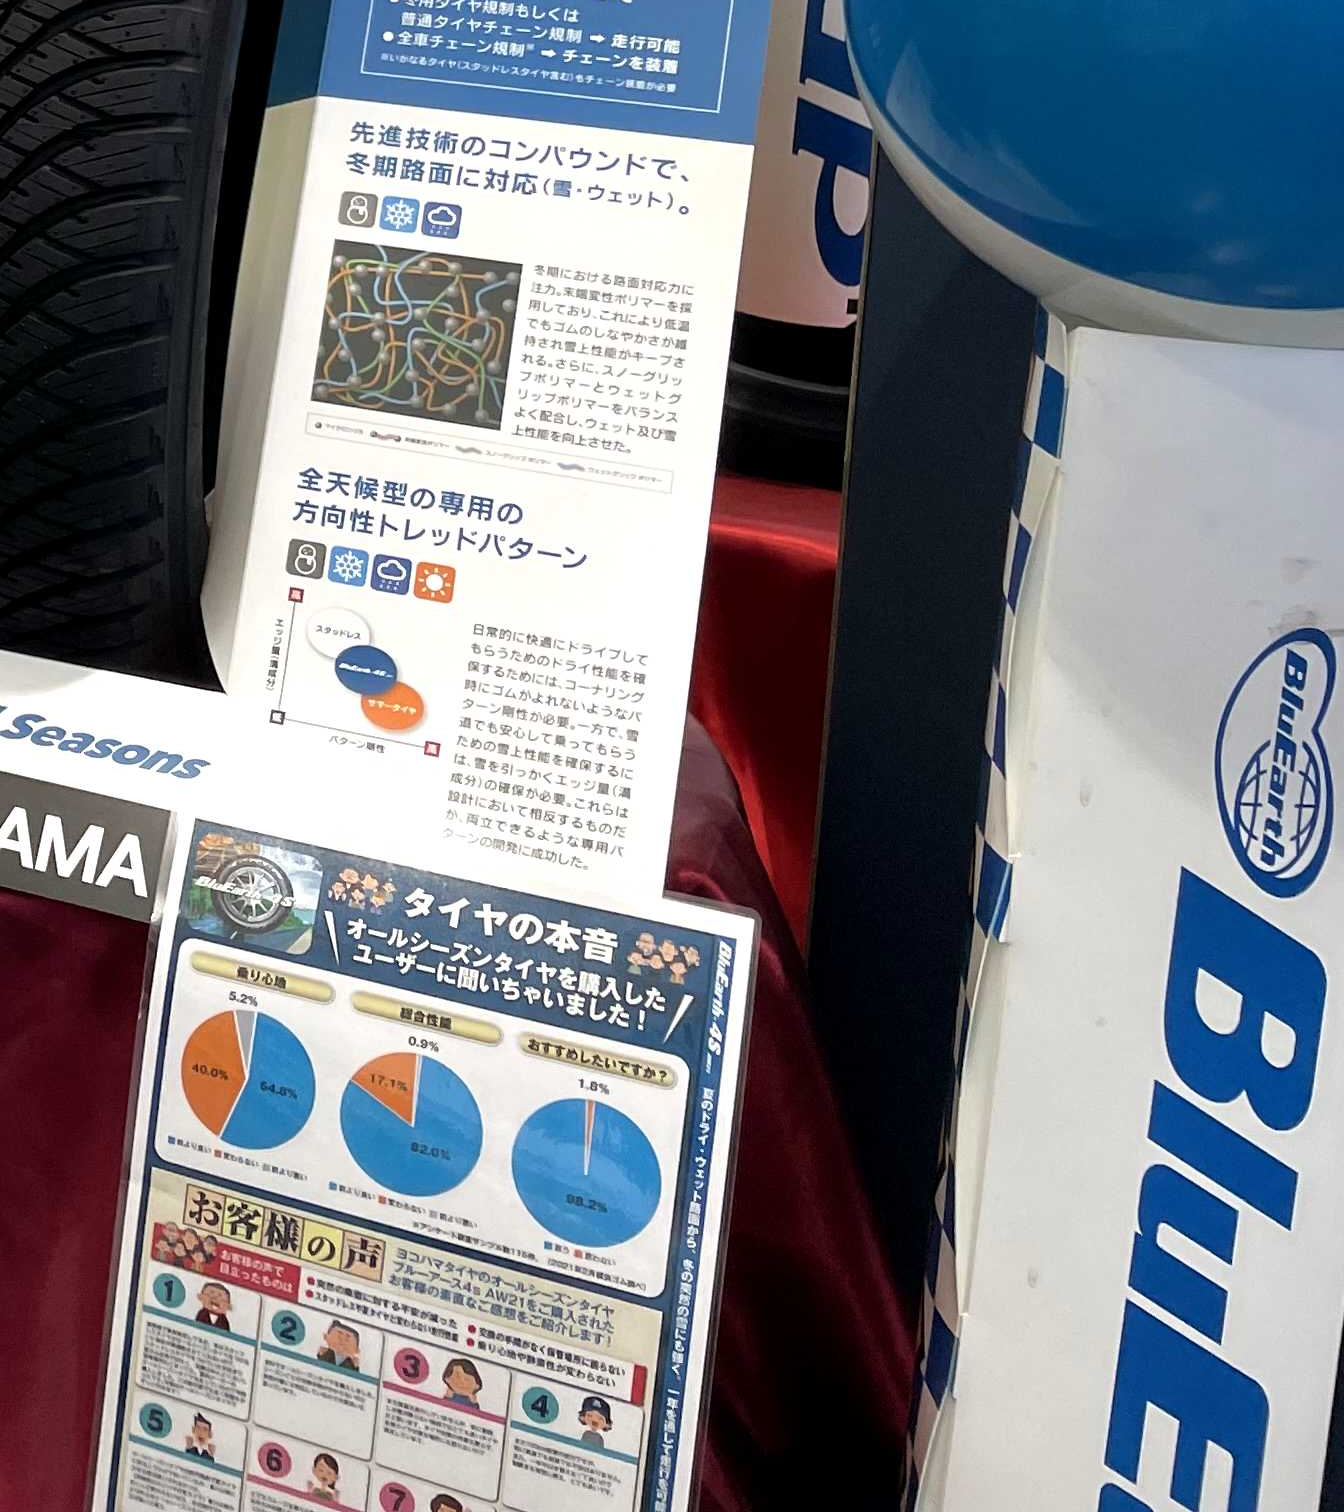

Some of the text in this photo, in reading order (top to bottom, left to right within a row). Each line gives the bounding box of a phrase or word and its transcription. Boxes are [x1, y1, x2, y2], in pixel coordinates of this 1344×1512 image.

[401, 12, 681, 54] 普通タイヤチェーン規制 走行可能
[562, 49, 678, 74] チェーンを装着
[534, 264, 694, 296] 冬期における路面対応力に
[527, 317, 687, 350] でもゴムのしなやかさが維
[524, 335, 685, 368] 持され雪上性能がキープさ
[521, 371, 681, 404] プポリマーとウェットグ
[518, 389, 679, 423] リップポリマーをバランス
[512, 427, 632, 455] 上性能を向上させた。
[298, 467, 522, 525] 全天候型の専用の
[293, 500, 588, 570] 方向性トレッドパターン
[315, 625, 361, 640] スタッドレス
[368, 698, 416, 715] サマータイヤ
[329, 736, 385, 754] パターン剛性
[1258, 646, 1309, 869] BluEarth
[441, 827, 589, 871] ターンの開発に成功した。
[404, 888, 618, 963] タイヤの本音
[236, 965, 287, 990] 乗り心地
[229, 991, 258, 1008] 5.2%
[400, 1006, 453, 1031] 総合性能
[409, 1035, 440, 1053] 0.9%
[191, 1065, 229, 1081] 40.0%
[527, 1038, 668, 1084] おすすめしたいですか?
[369, 1073, 408, 1092] 17.1%
[578, 1079, 609, 1095] 1.8%
[188, 1190, 385, 1273] お客様の声
[219, 1262, 294, 1294] 目立ったものは
[221, 1248, 284, 1278] お客様の声で
